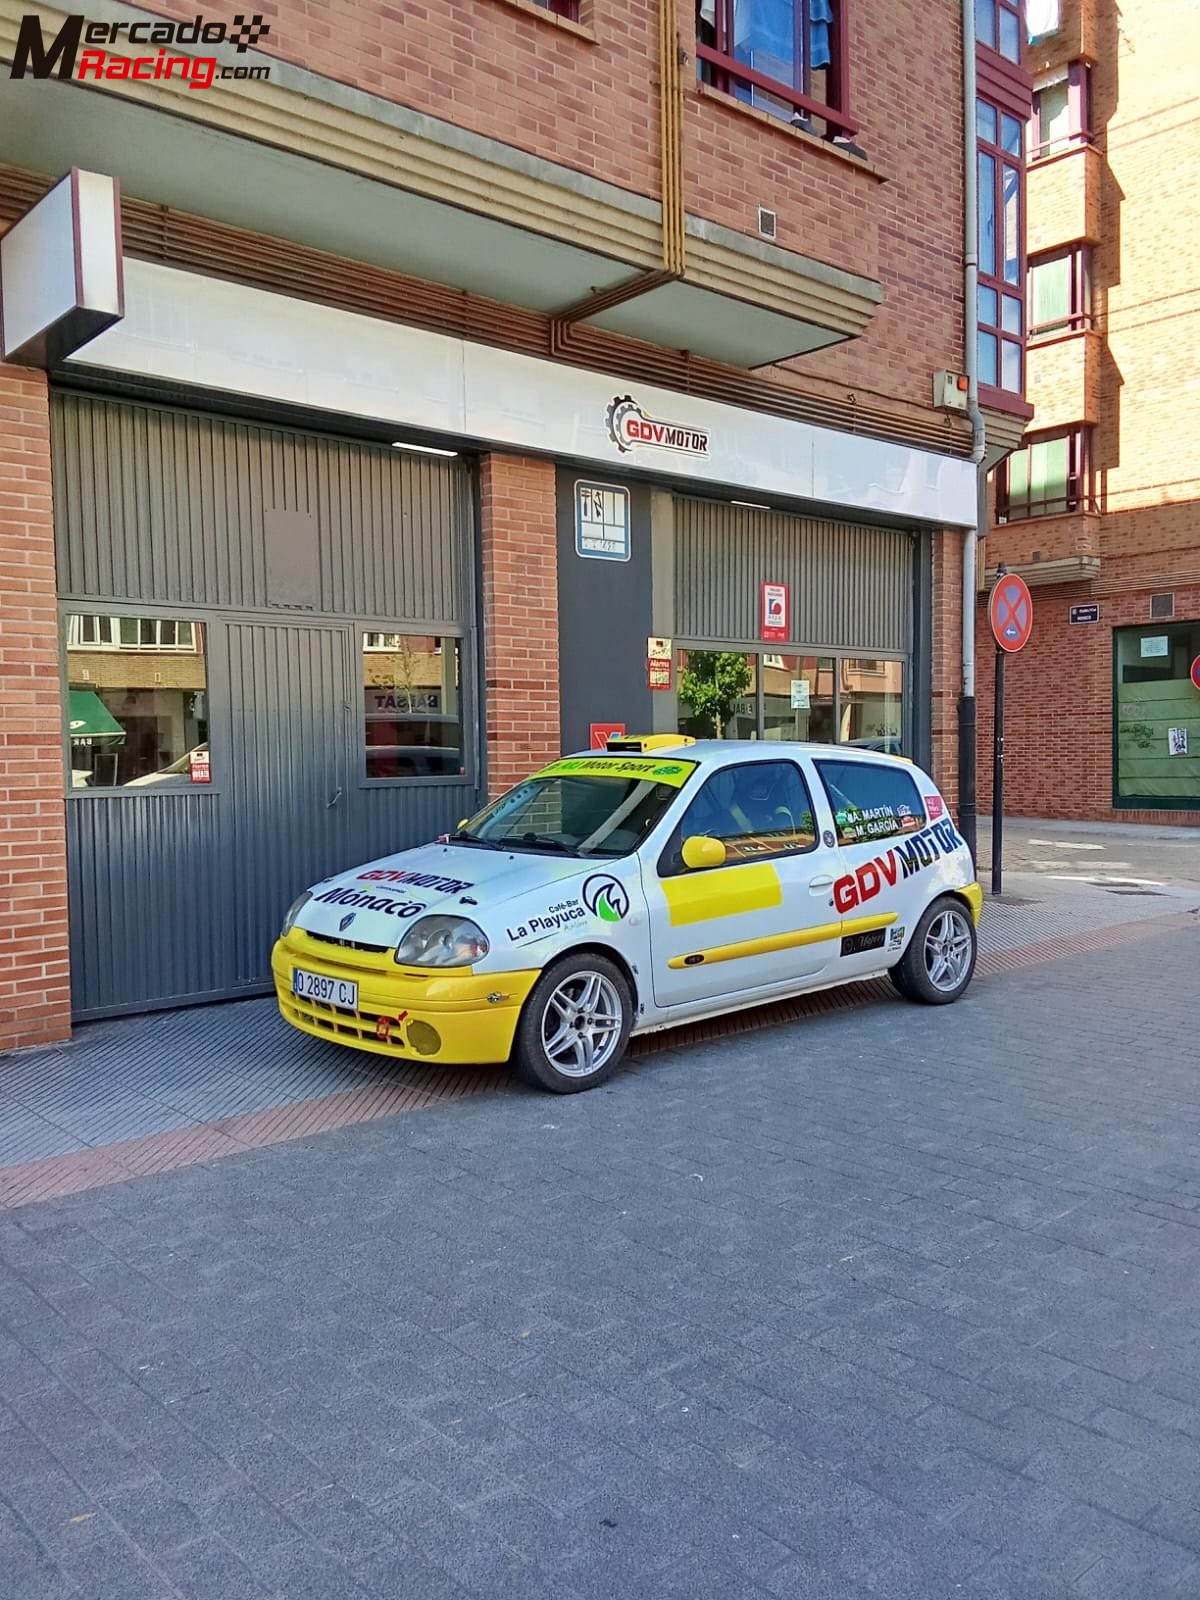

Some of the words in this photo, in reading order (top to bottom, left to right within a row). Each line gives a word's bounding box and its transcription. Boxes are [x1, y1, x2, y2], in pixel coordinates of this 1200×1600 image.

[862, 804, 894, 819] MARTÍN
[867, 817, 898, 833] GARCÍA
[548, 899, 579, 914] Café-Bar
[506, 928, 528, 941] La
[528, 907, 586, 933] Playuca
[307, 975, 335, 1000] 2897
[339, 983, 355, 1005] CJ
